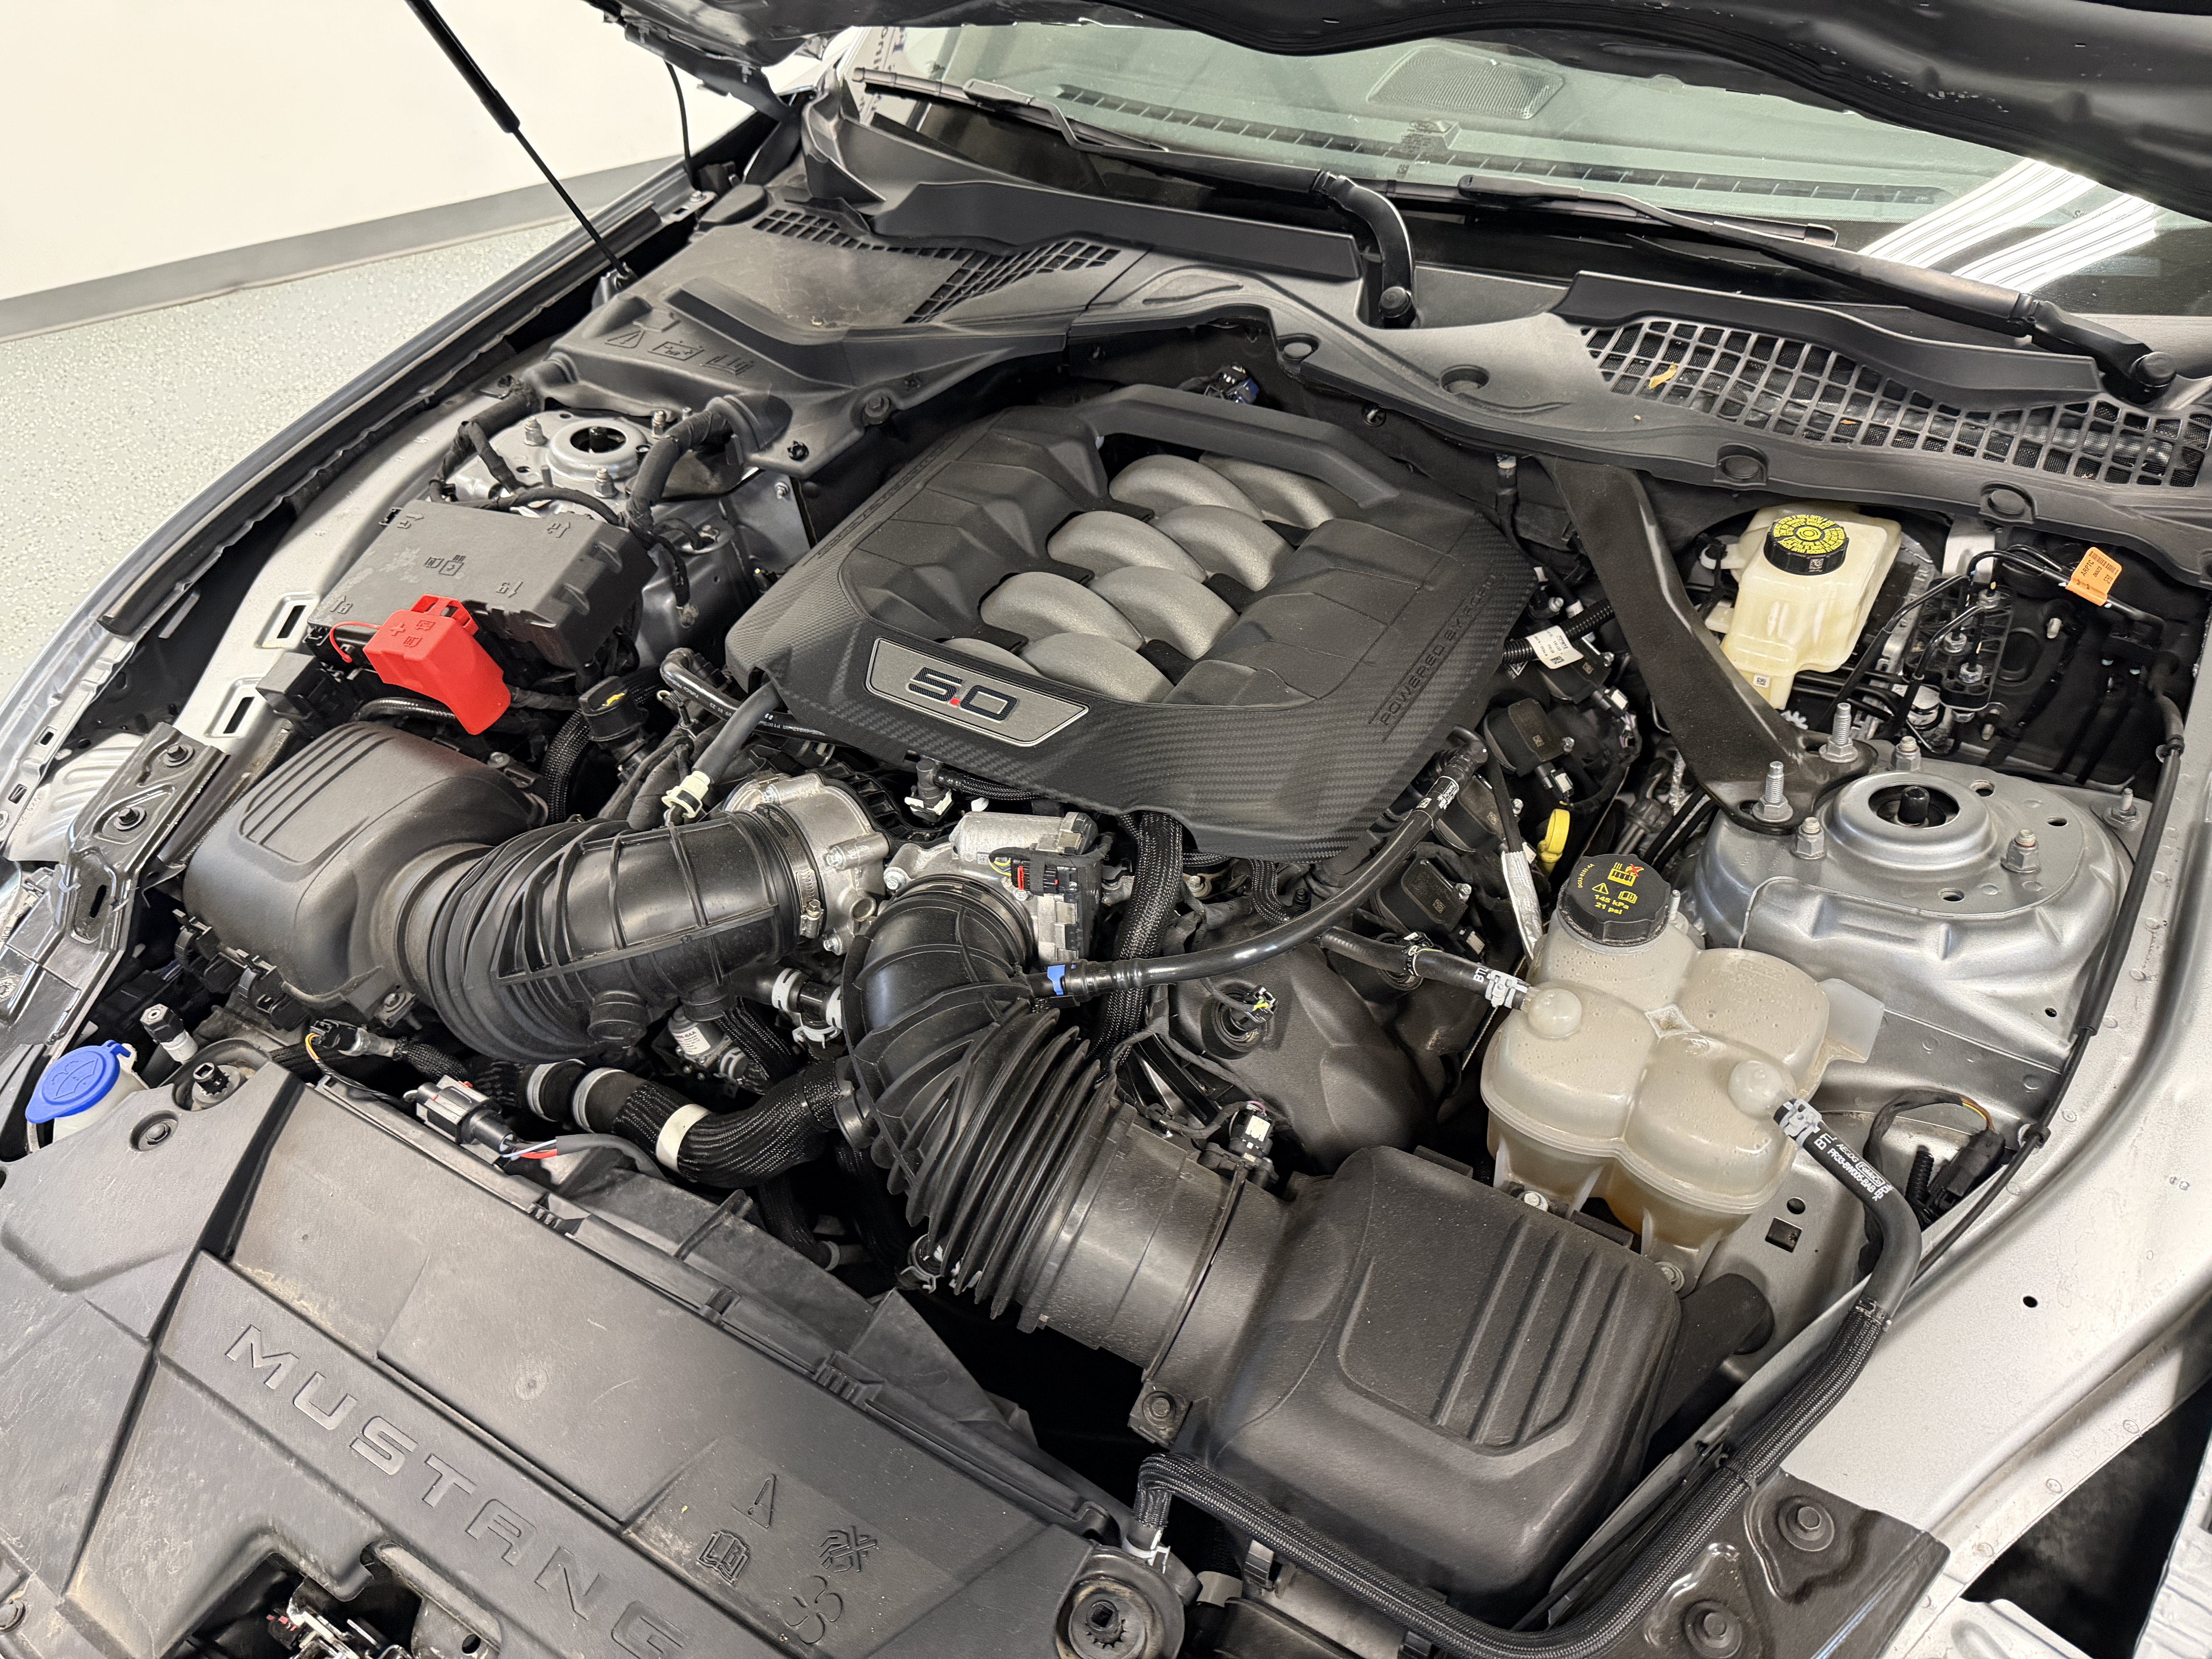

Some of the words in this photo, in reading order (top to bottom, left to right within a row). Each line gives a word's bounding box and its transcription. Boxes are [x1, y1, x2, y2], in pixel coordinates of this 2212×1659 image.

[2081, 560, 2094, 576] ARPTC
[1380, 644, 1445, 726] POWERED
[1444, 618, 1463, 641] BY
[905, 666, 1019, 723] 5.0
[1595, 894, 1611, 903] 145
[1612, 899, 1629, 910] kPa
[1858, 1164, 1882, 1185] FoMoCo
[225, 1324, 689, 1659] MUSTANG
